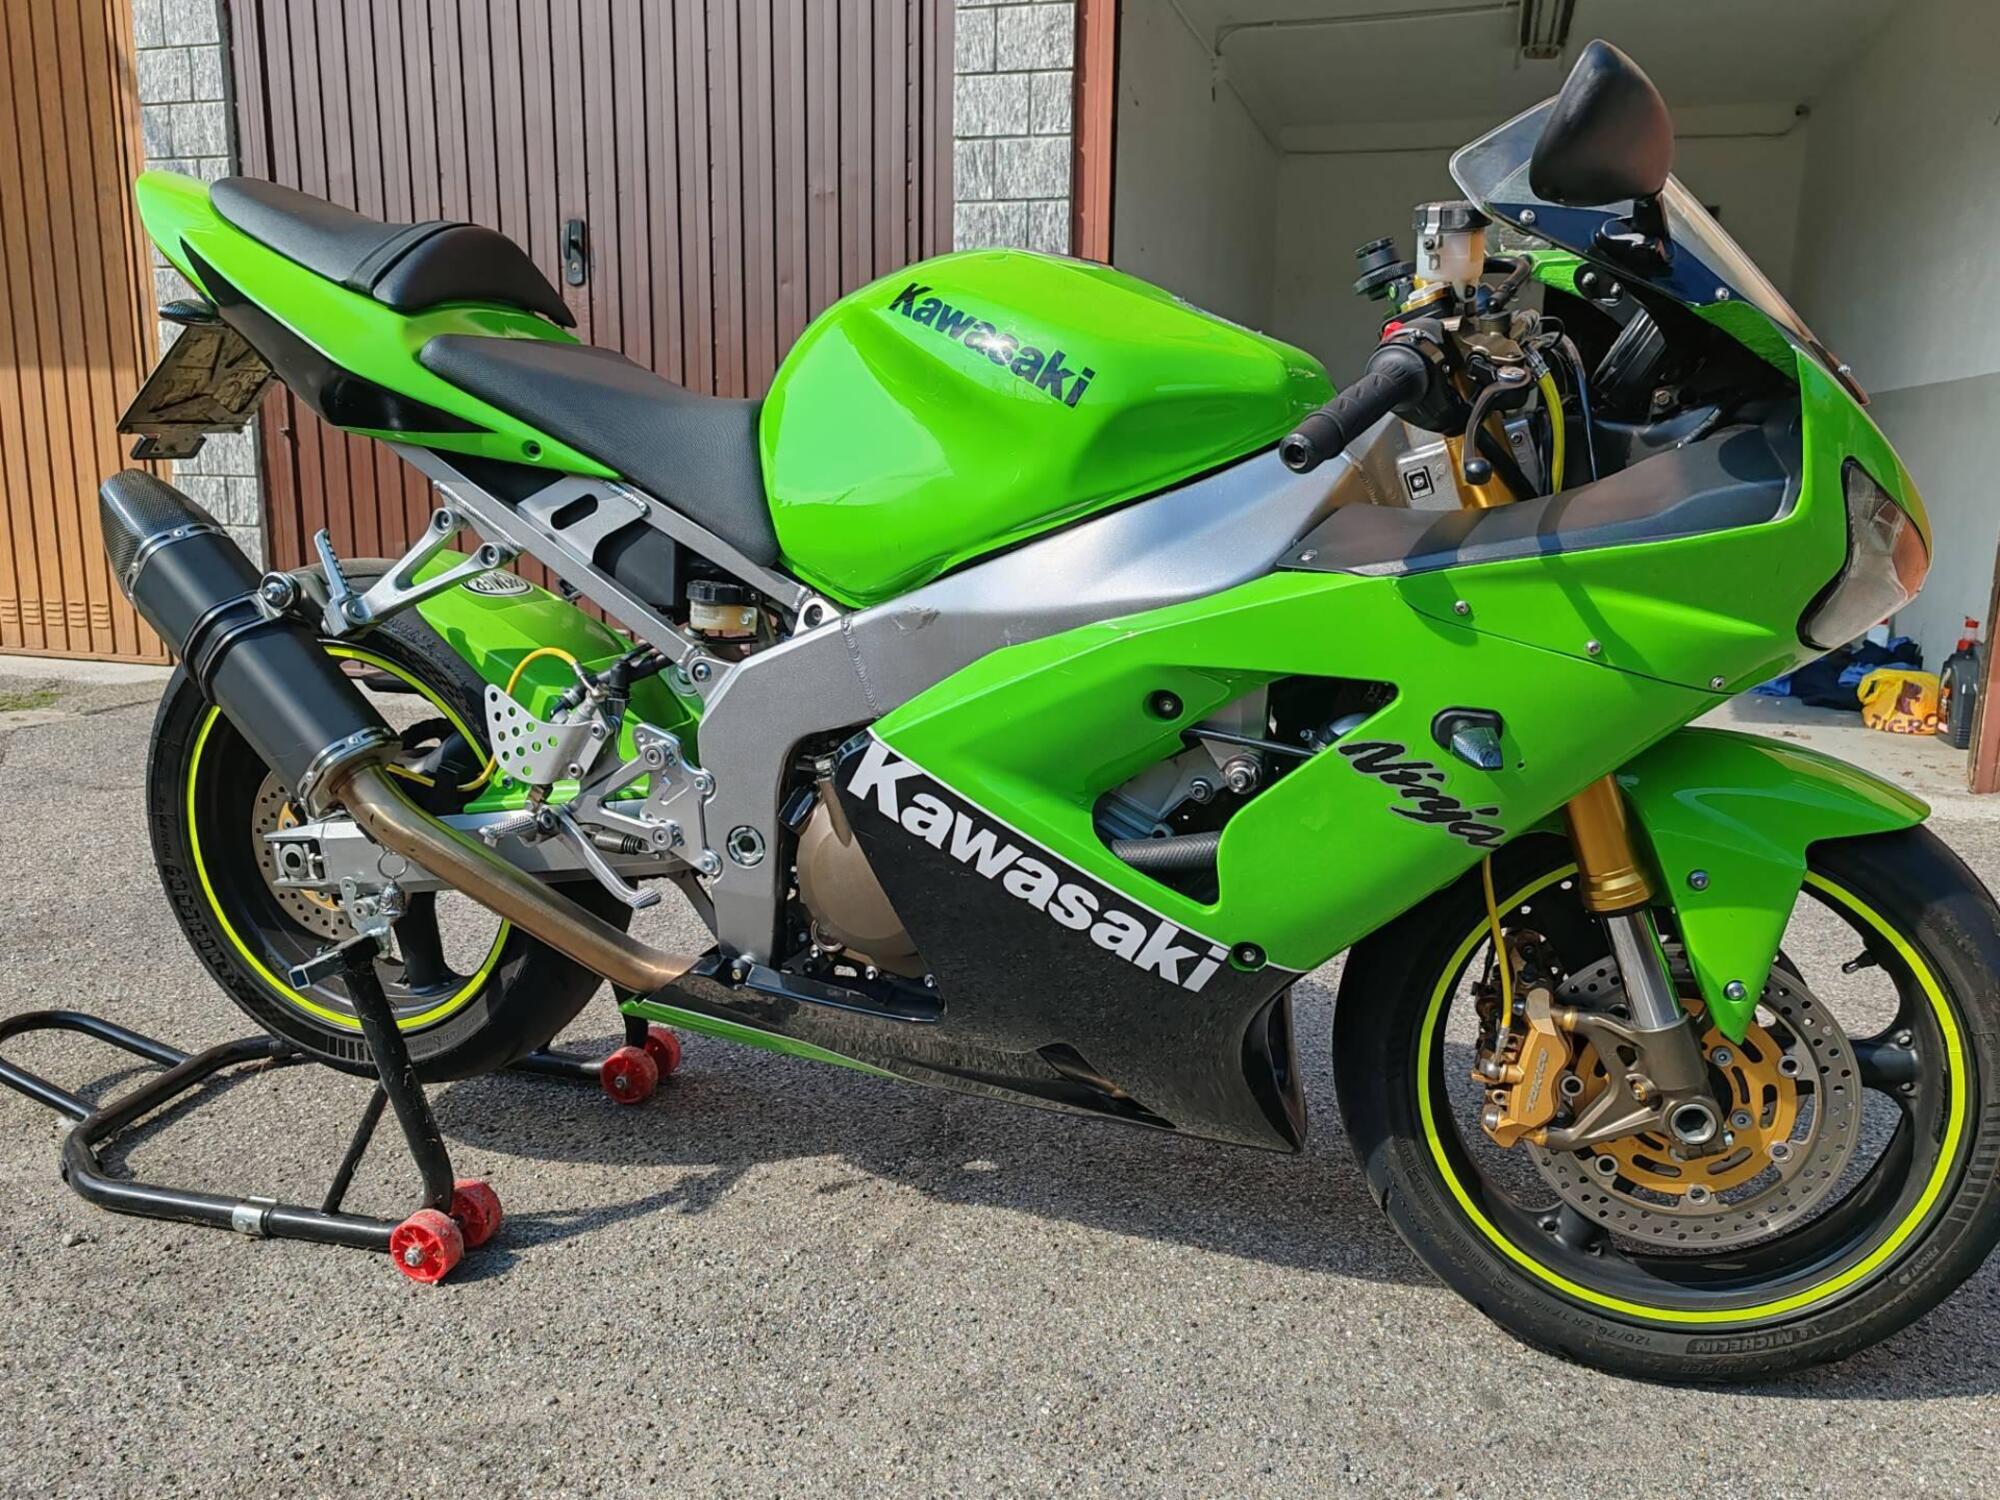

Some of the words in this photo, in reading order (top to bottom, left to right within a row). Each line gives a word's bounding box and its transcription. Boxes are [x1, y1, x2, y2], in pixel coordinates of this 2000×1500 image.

[888, 282, 1096, 408] Kawasaki
[1338, 742, 1505, 848] Ninja
[846, 741, 1230, 993] Kawasaki
[1695, 1330, 1794, 1353] MICHELIN
